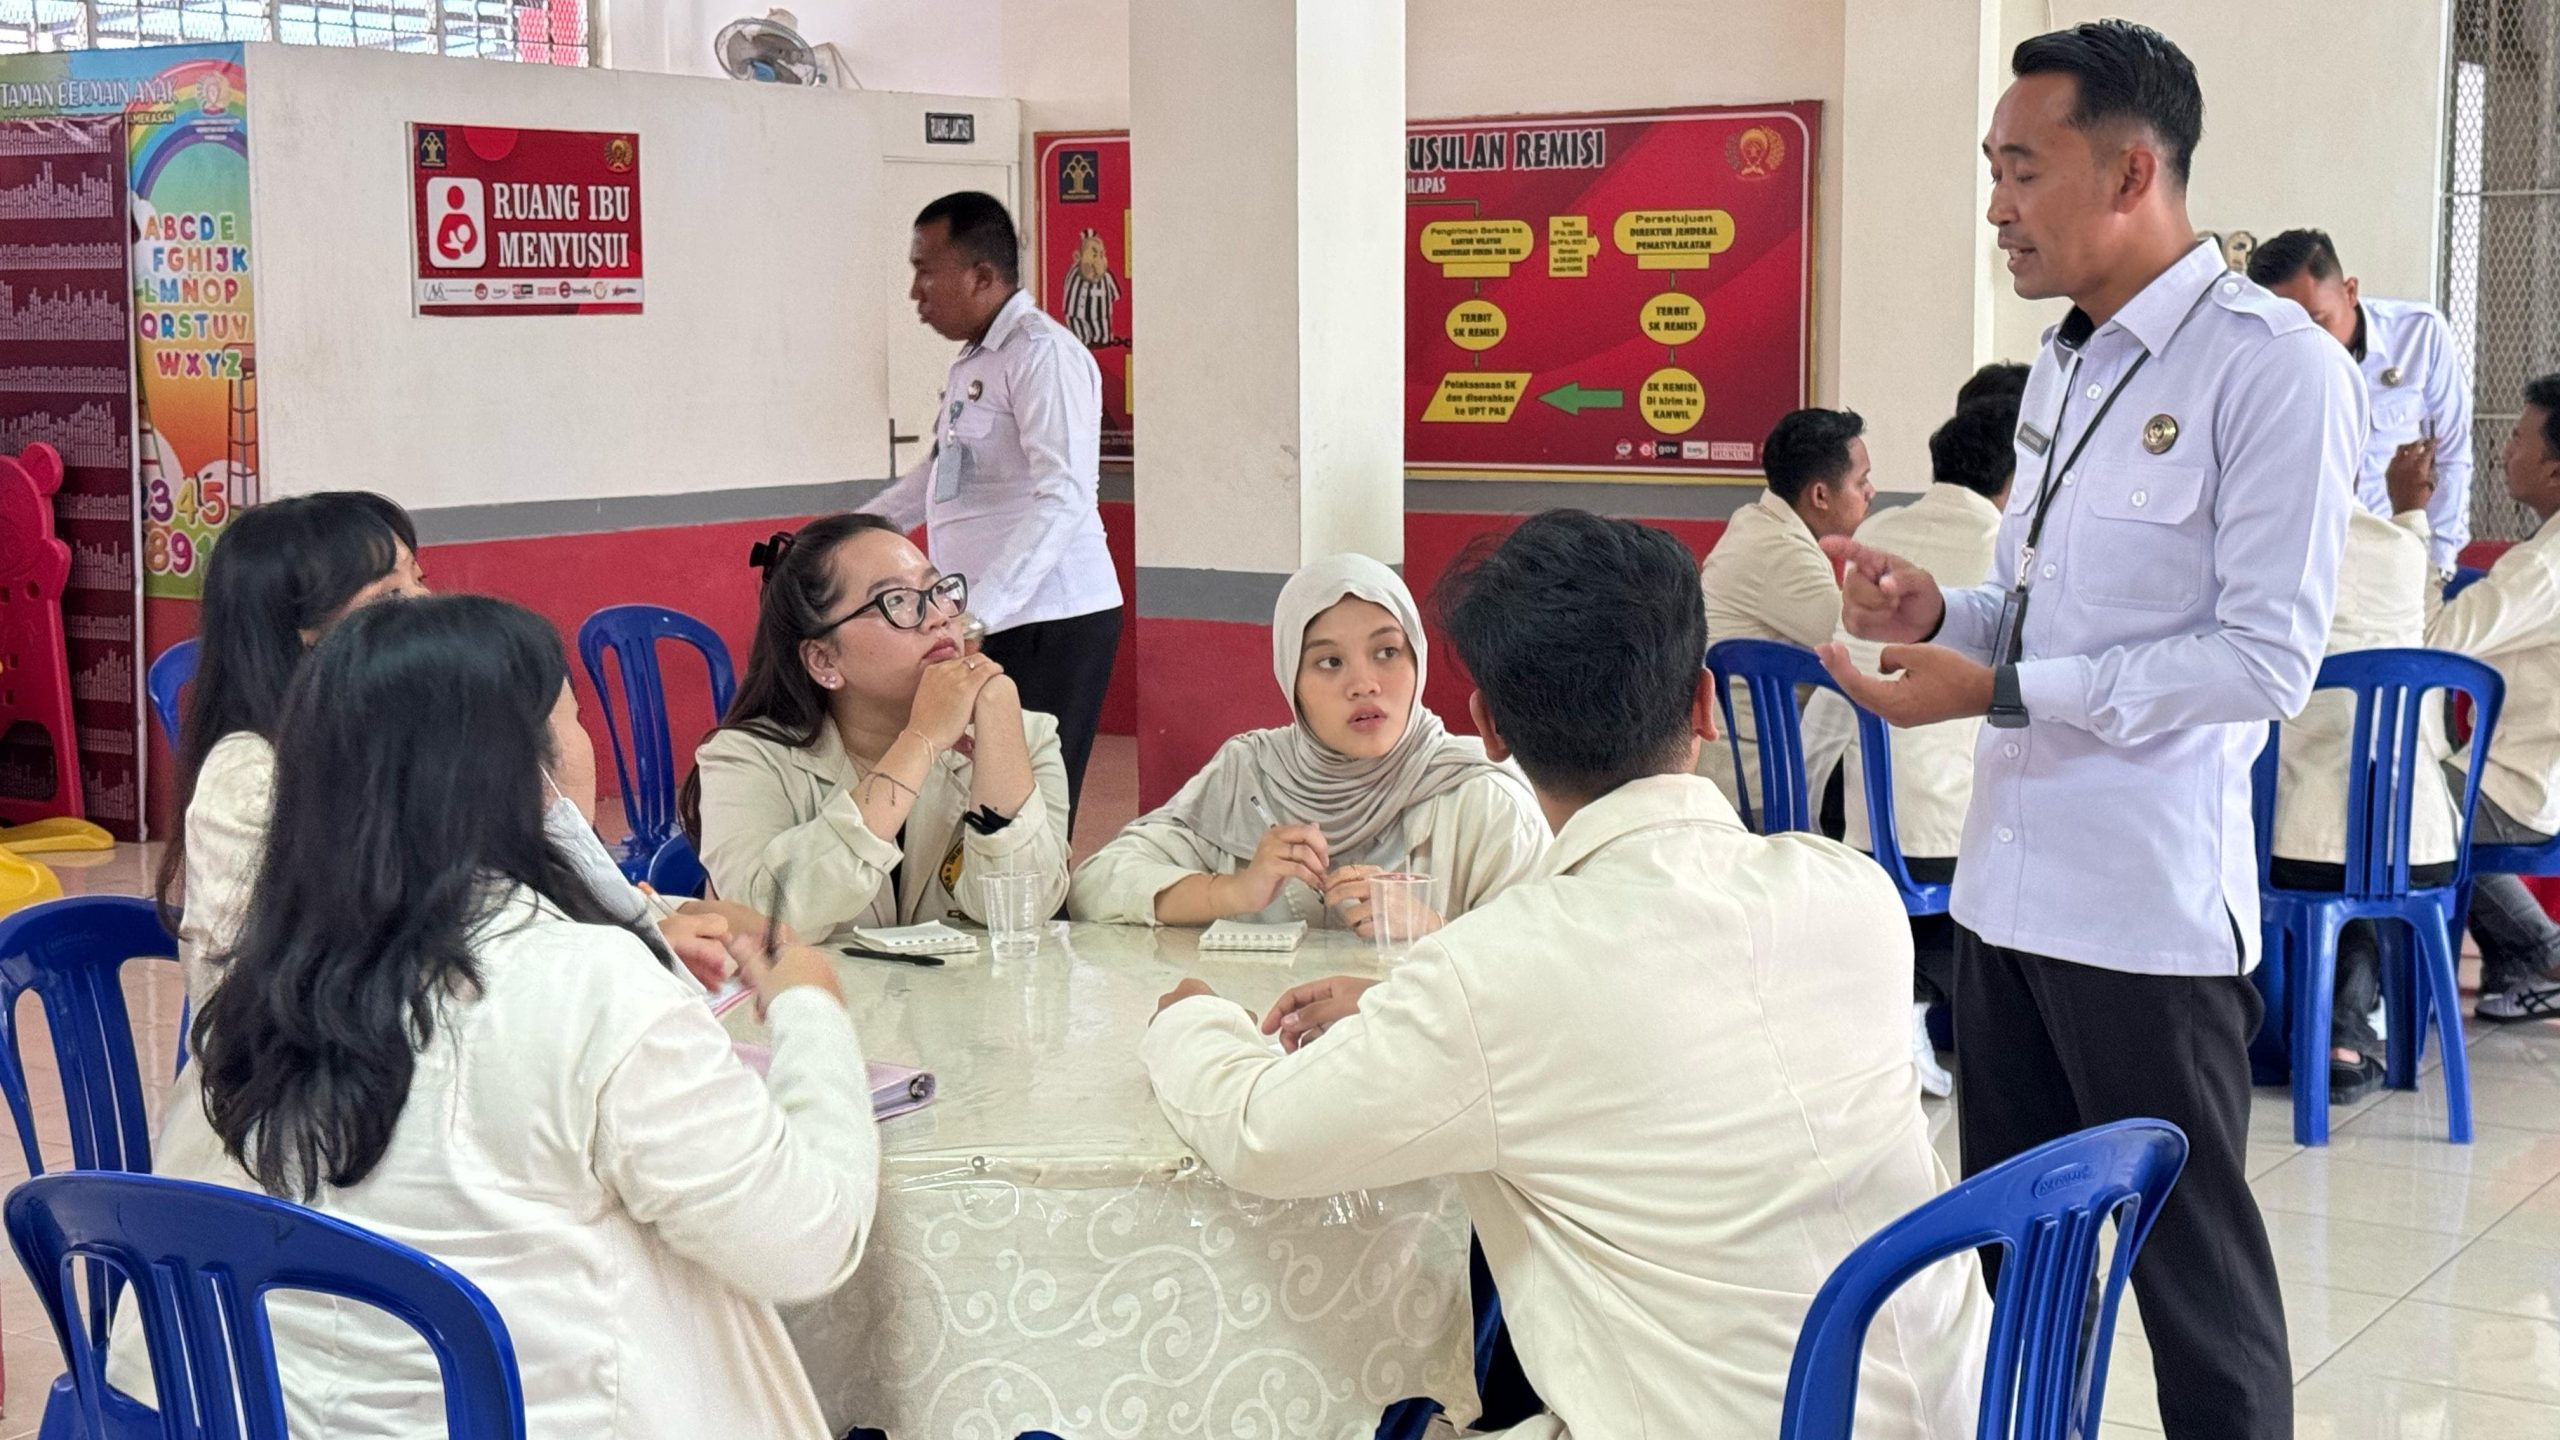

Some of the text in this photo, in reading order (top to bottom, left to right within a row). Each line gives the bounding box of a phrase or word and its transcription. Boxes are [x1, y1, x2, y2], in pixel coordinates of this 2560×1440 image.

[0, 78, 178, 108] TAMAN BERMAIN ANAK
[1406, 129, 1605, 172] USULAN REMISI
[1407, 177, 1446, 194] ILAPAS
[492, 183, 630, 221] RUANG IBU
[1635, 214, 1713, 225] Persetujuan
[1630, 226, 1718, 237] DIREKTUR JENDERAL
[498, 232, 630, 268] MENYUSUI
[1656, 306, 1690, 316] TERBIT
[1460, 313, 1492, 323] TERBIT
[1648, 321, 1697, 331] SK REMISI
[1453, 328, 1499, 337] SK REMISI
[1504, 380, 1516, 389] SK
[1647, 382, 1697, 392] SK REMISI
[1446, 393, 1515, 403] dan diserahkan
[1686, 397, 1698, 406] ke
[1455, 406, 1506, 416] ke UPT PAS
[1653, 410, 1691, 419] KANWIL
